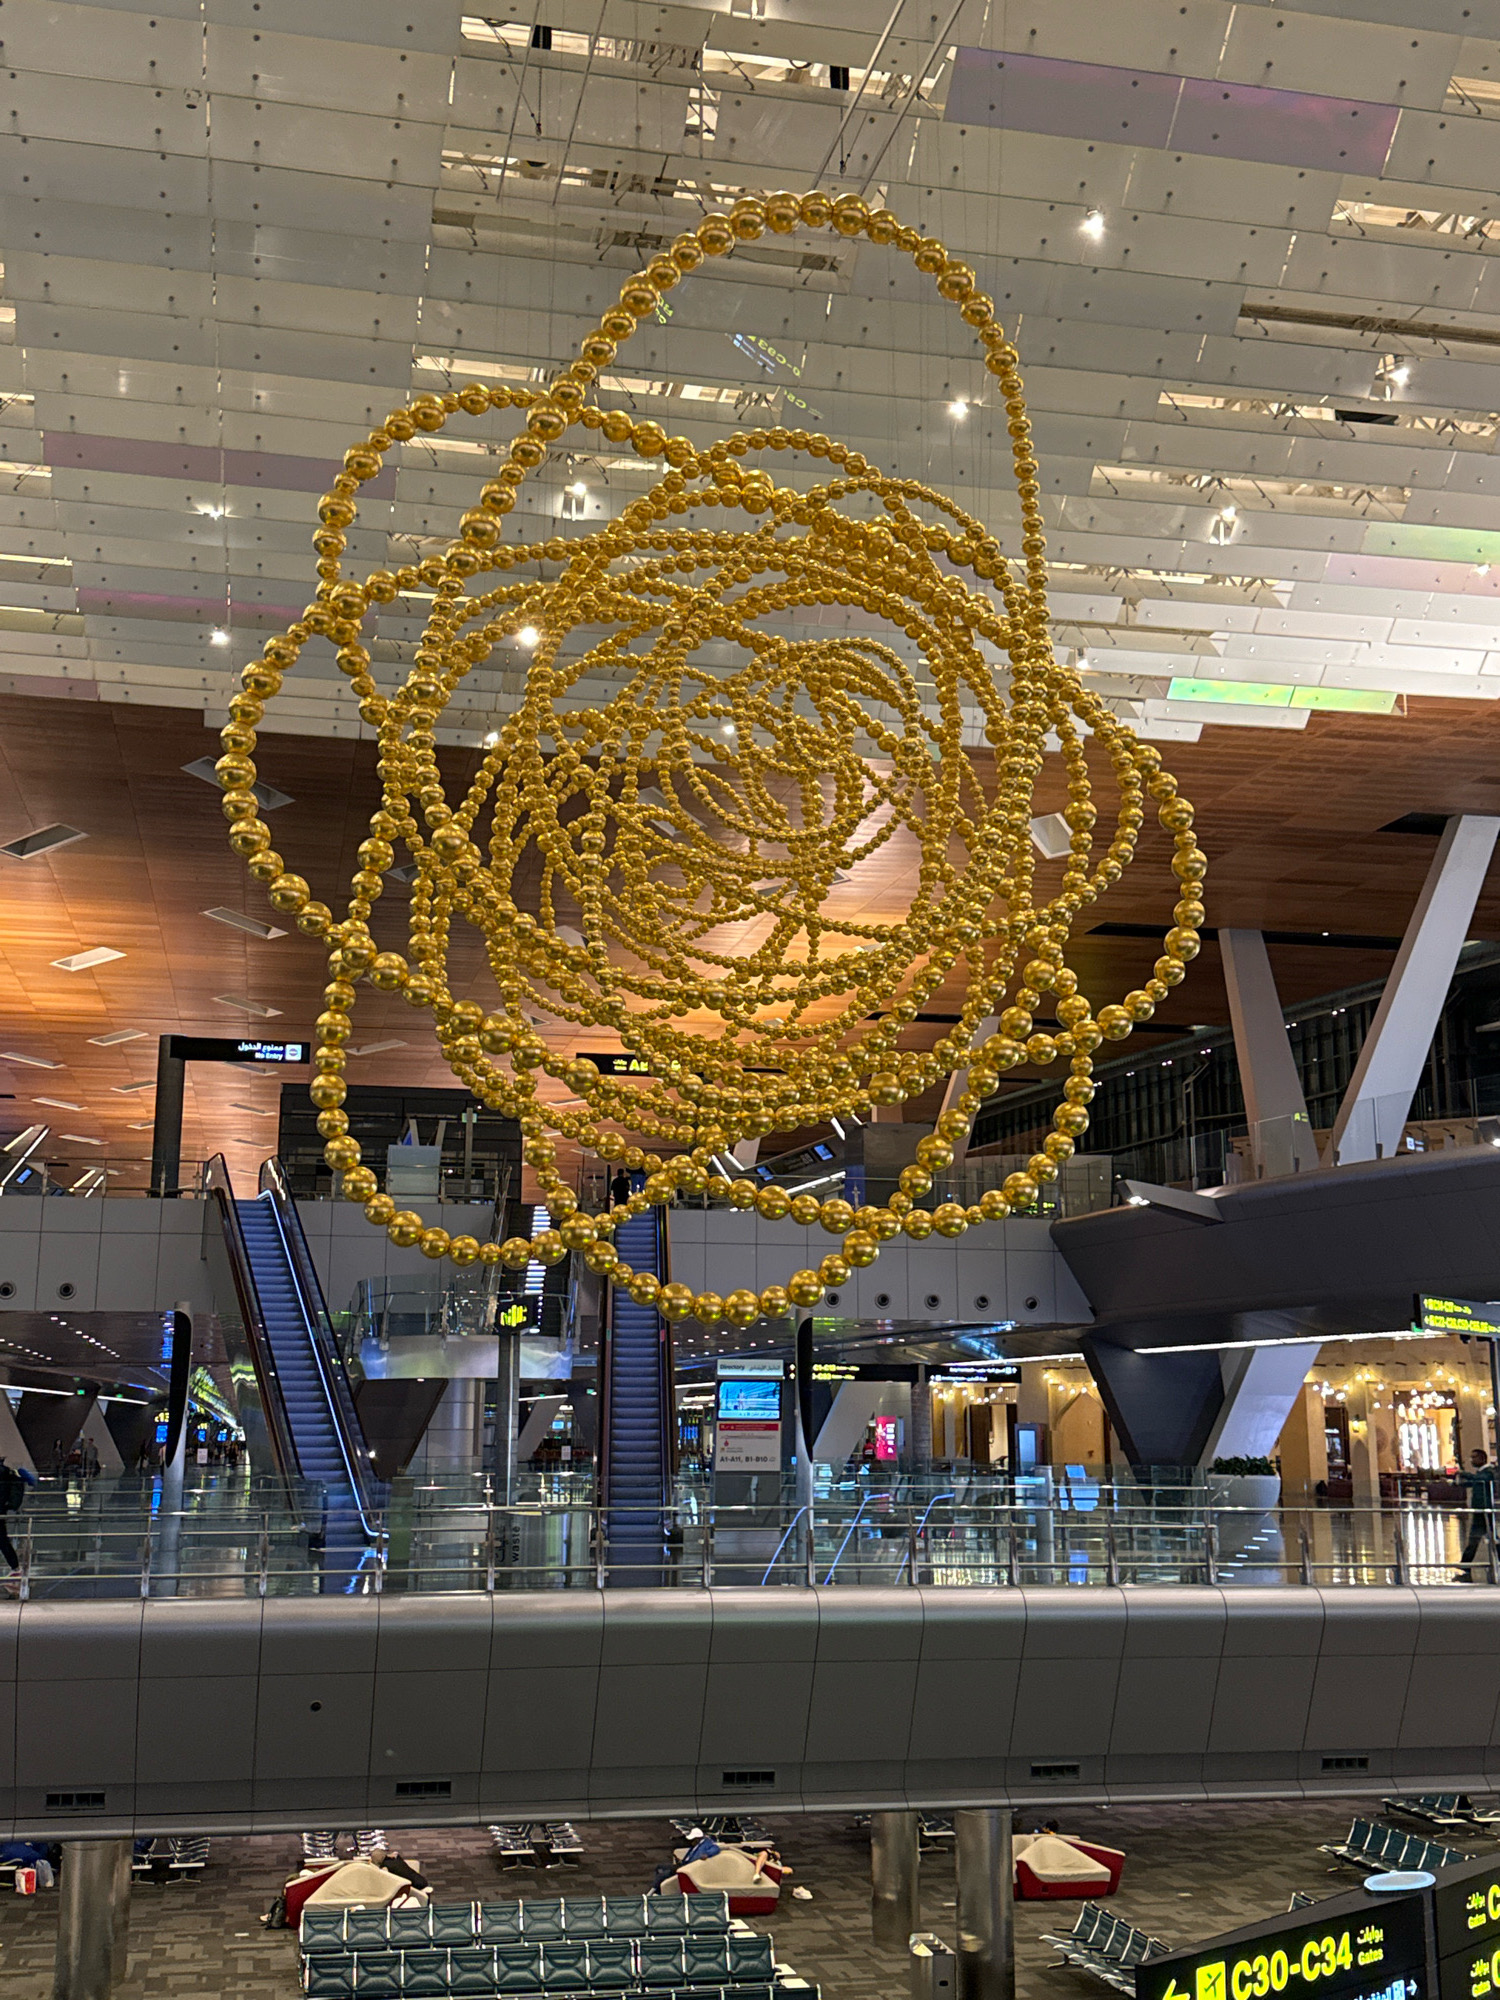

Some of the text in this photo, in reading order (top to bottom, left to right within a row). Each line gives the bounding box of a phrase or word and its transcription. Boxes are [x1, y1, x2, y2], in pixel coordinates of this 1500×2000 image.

[265, 1052, 283, 1061] Entry
[512, 1526, 521, 1562] waste
[1356, 1925, 1384, 1945] بوابات
[1231, 1931, 1354, 2000] C30-C34
[1358, 1948, 1384, 1966] Gates
